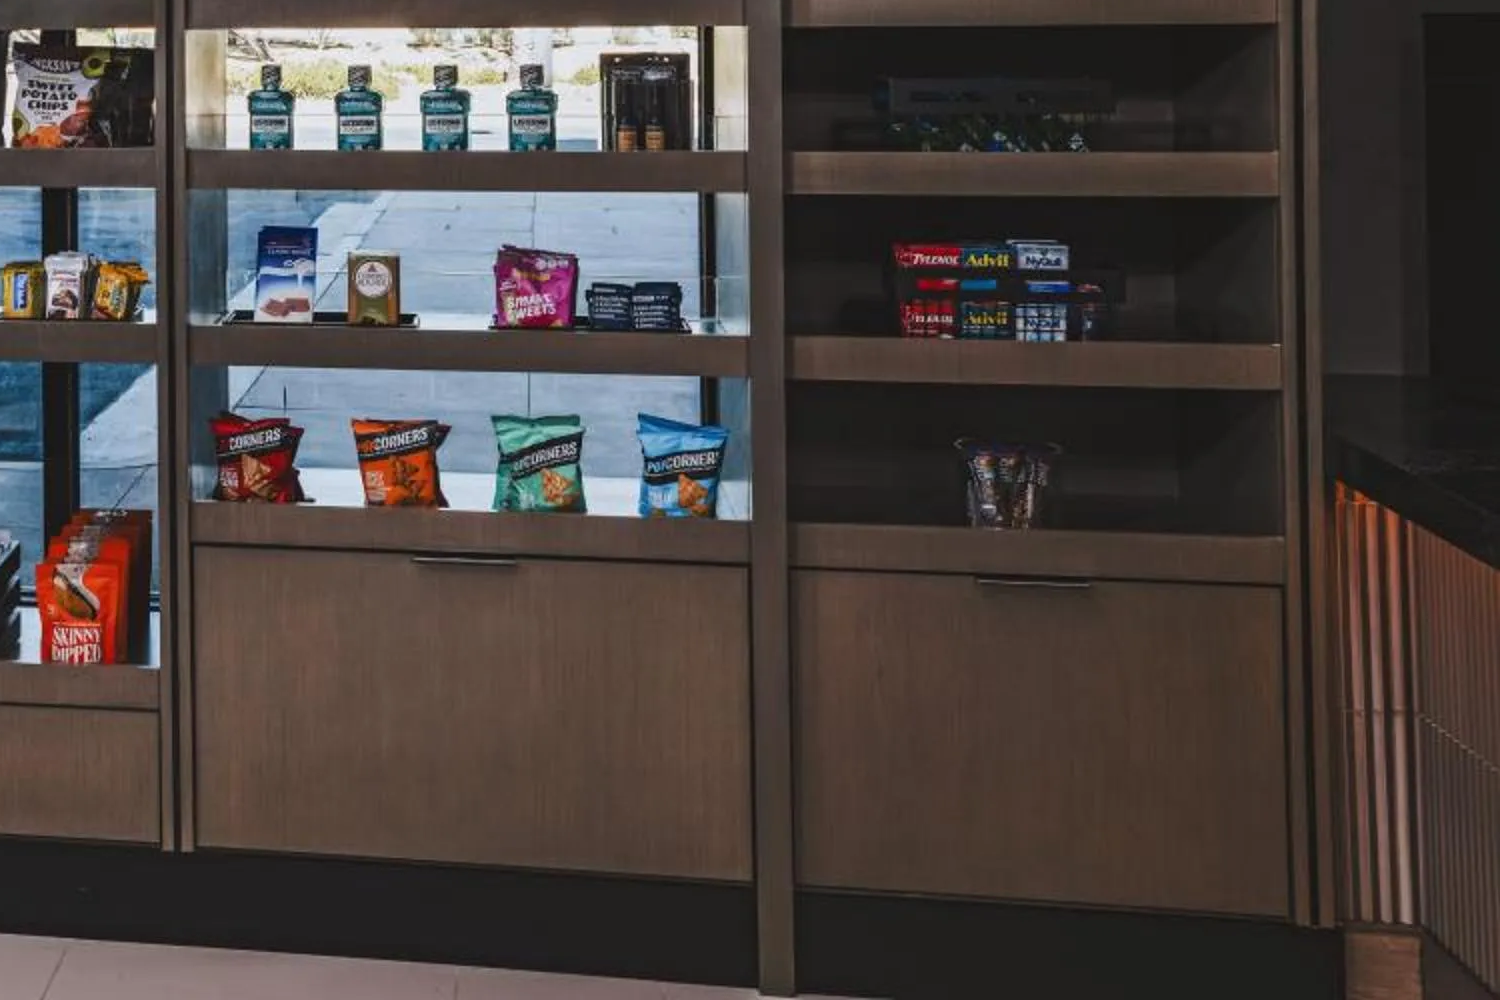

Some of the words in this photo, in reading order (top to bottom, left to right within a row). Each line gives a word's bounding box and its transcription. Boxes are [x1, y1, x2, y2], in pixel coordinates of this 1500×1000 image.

[27, 79, 75, 91] SWEET
[21, 88, 78, 101] POTATO
[27, 100, 69, 111] CHIPS
[912, 254, 959, 265] TYLENOL
[965, 254, 1010, 267] Advil
[51, 627, 101, 646] SKINNY
[51, 646, 101, 664] DIPPED
